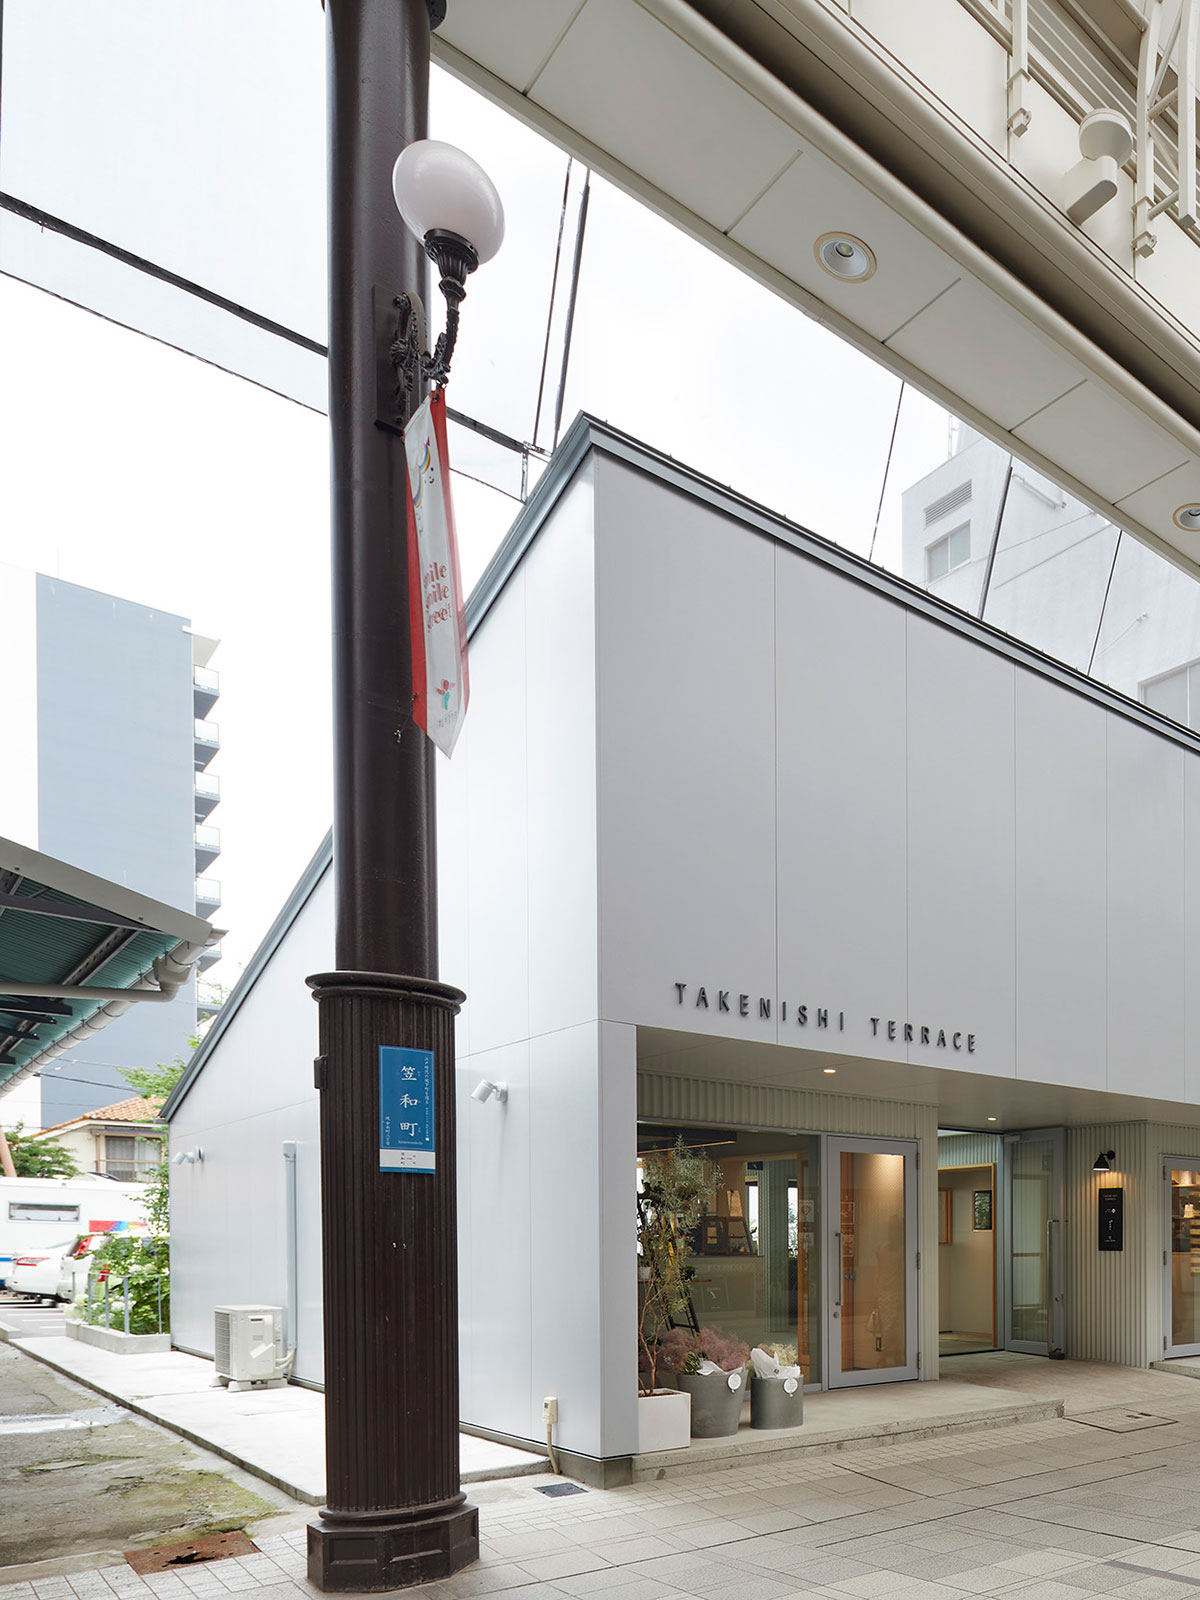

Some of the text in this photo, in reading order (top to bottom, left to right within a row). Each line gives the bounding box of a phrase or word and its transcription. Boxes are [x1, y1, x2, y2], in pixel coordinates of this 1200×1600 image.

[674, 982, 976, 1052] TAKENISHI TERRACE
[400, 1066, 418, 1137] 笠和町
